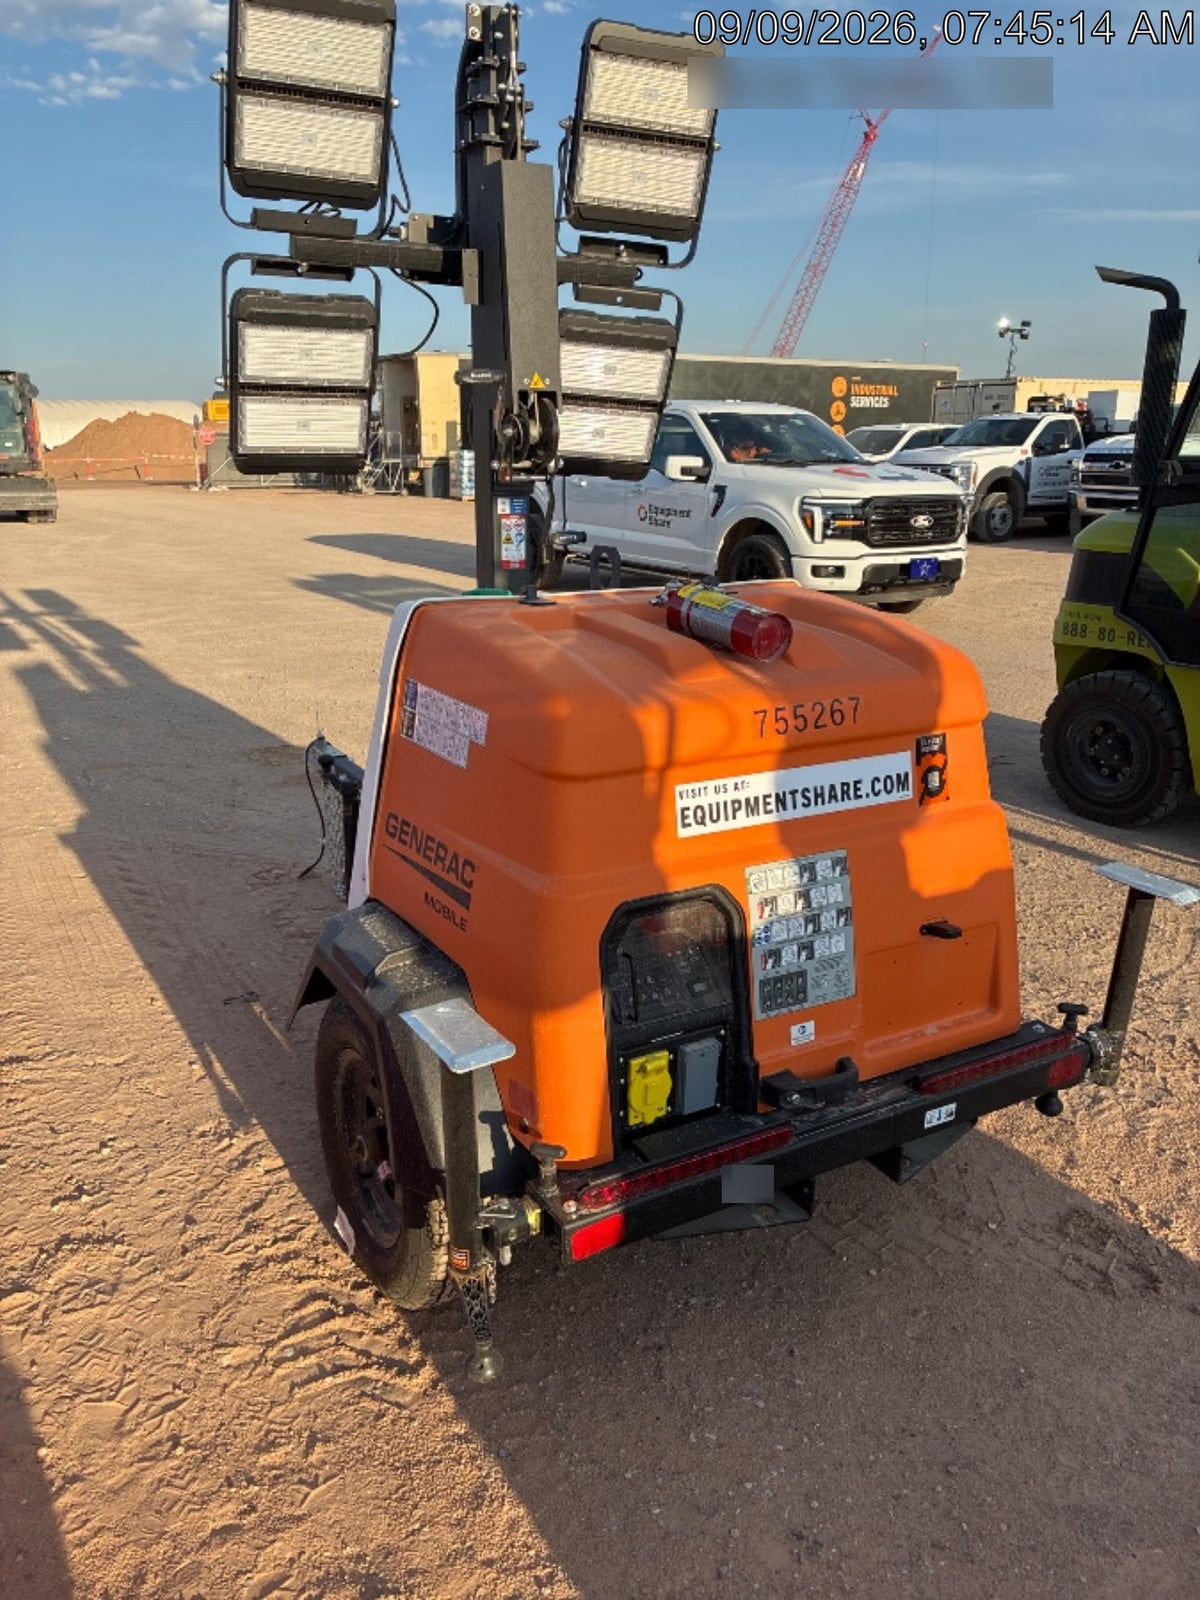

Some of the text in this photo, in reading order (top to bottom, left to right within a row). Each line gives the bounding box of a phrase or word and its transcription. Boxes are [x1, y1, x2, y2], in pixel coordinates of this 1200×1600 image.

[850, 396, 889, 408] SERVICES
[753, 696, 861, 738] 755267
[678, 780, 750, 800] VISIT US AT:
[680, 771, 910, 829] EQUIPMENTSHARE.COM
[385, 811, 476, 889] GENERAC
[424, 892, 469, 932] MOBILE
